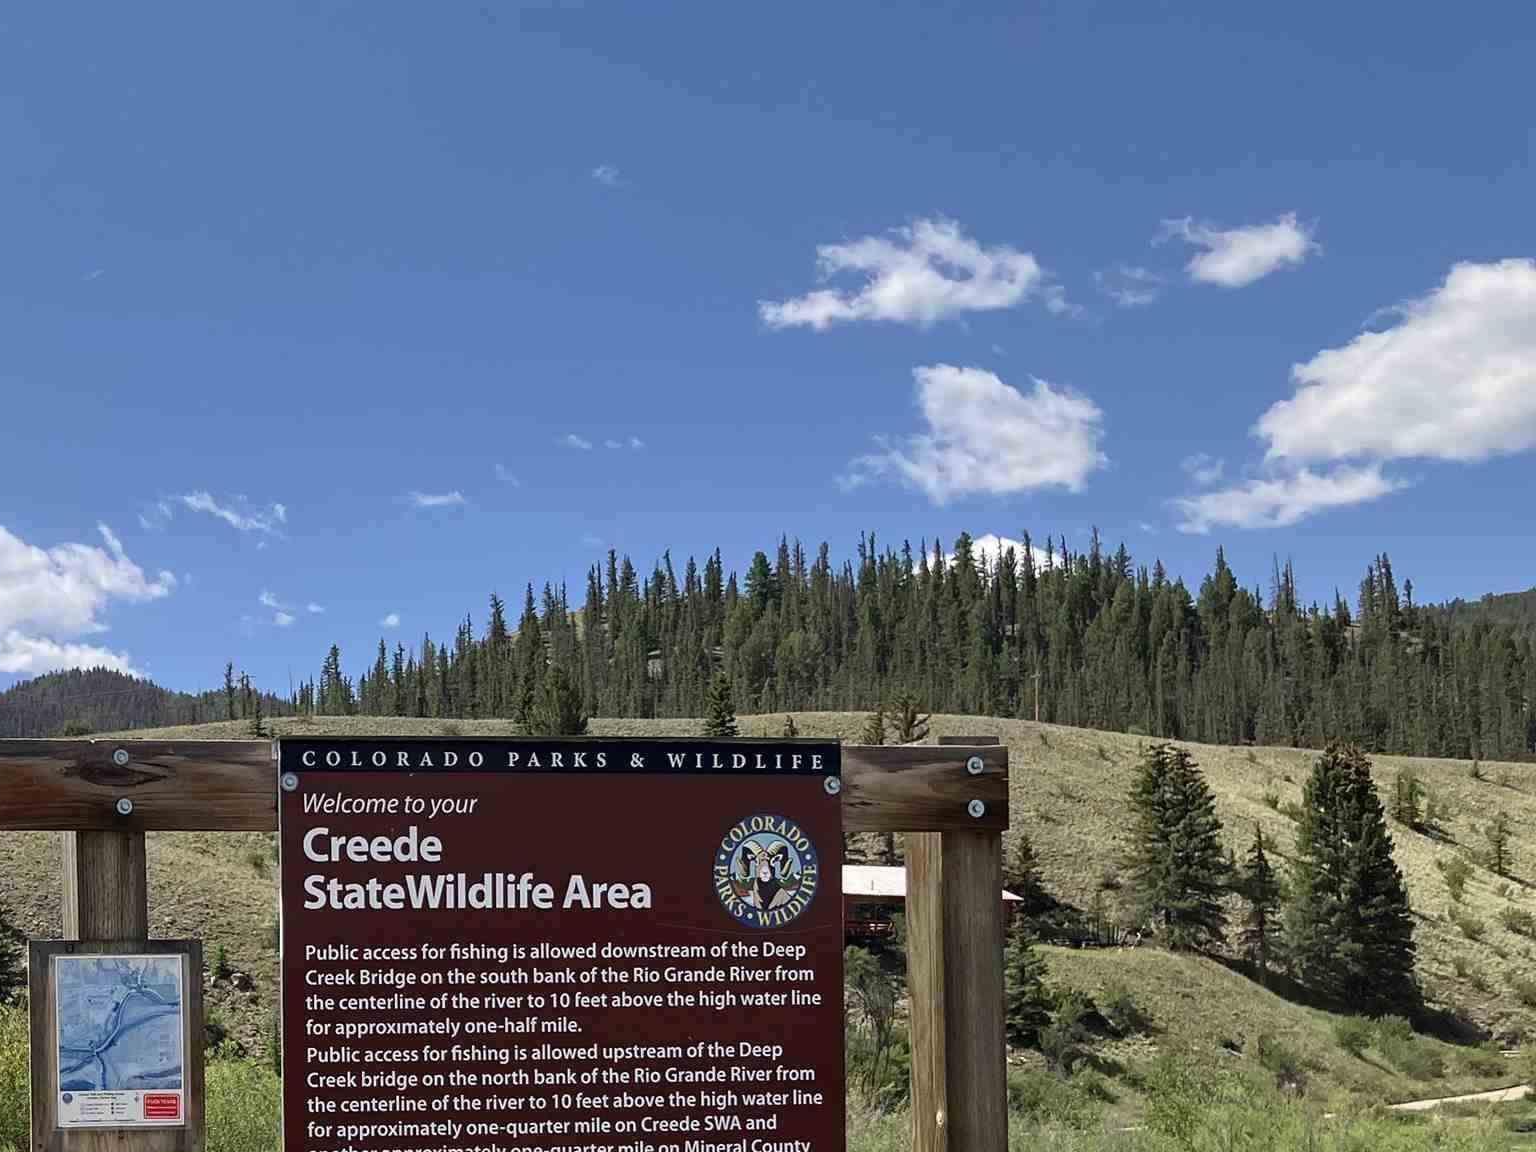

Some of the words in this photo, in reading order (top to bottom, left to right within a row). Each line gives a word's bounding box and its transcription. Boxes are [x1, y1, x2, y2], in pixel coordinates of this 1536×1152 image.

[302, 750, 484, 767] COLORADO
[508, 751, 607, 768] PARKS
[630, 752, 645, 768] &
[666, 752, 823, 770] WILDLIFE
[303, 792, 399, 814] Welcome
[404, 795, 425, 814] to
[428, 798, 478, 819] your
[303, 825, 443, 862] Creede
[721, 816, 810, 852] COLORADO
[562, 874, 652, 909] Area
[714, 864, 746, 917] PARKS
[757, 864, 817, 926] WILDLIFE
[305, 944, 359, 961] Public
[363, 947, 418, 960] access
[421, 943, 447, 960] for
[449, 943, 508, 963] fishing
[512, 943, 526, 959] is
[530, 942, 597, 959] allowed
[600, 942, 706, 959] downstream
[710, 941, 729, 958] of
[730, 941, 759, 958] the
[763, 941, 806, 961] Deep
[305, 1018, 332, 1035] for
[335, 1017, 461, 1039] approximately
[464, 1016, 538, 1034] one-half
[541, 1016, 582, 1033] mile.
[307, 1121, 333, 1138] for
[336, 1119, 463, 1141] approximately
[466, 1120, 571, 1138] one-quarter
[574, 1117, 611, 1133] mile
[614, 1120, 637, 1133] on
[641, 1115, 701, 1132] Creede
[704, 1115, 742, 1131] SWA
[745, 1113, 777, 1130] and
